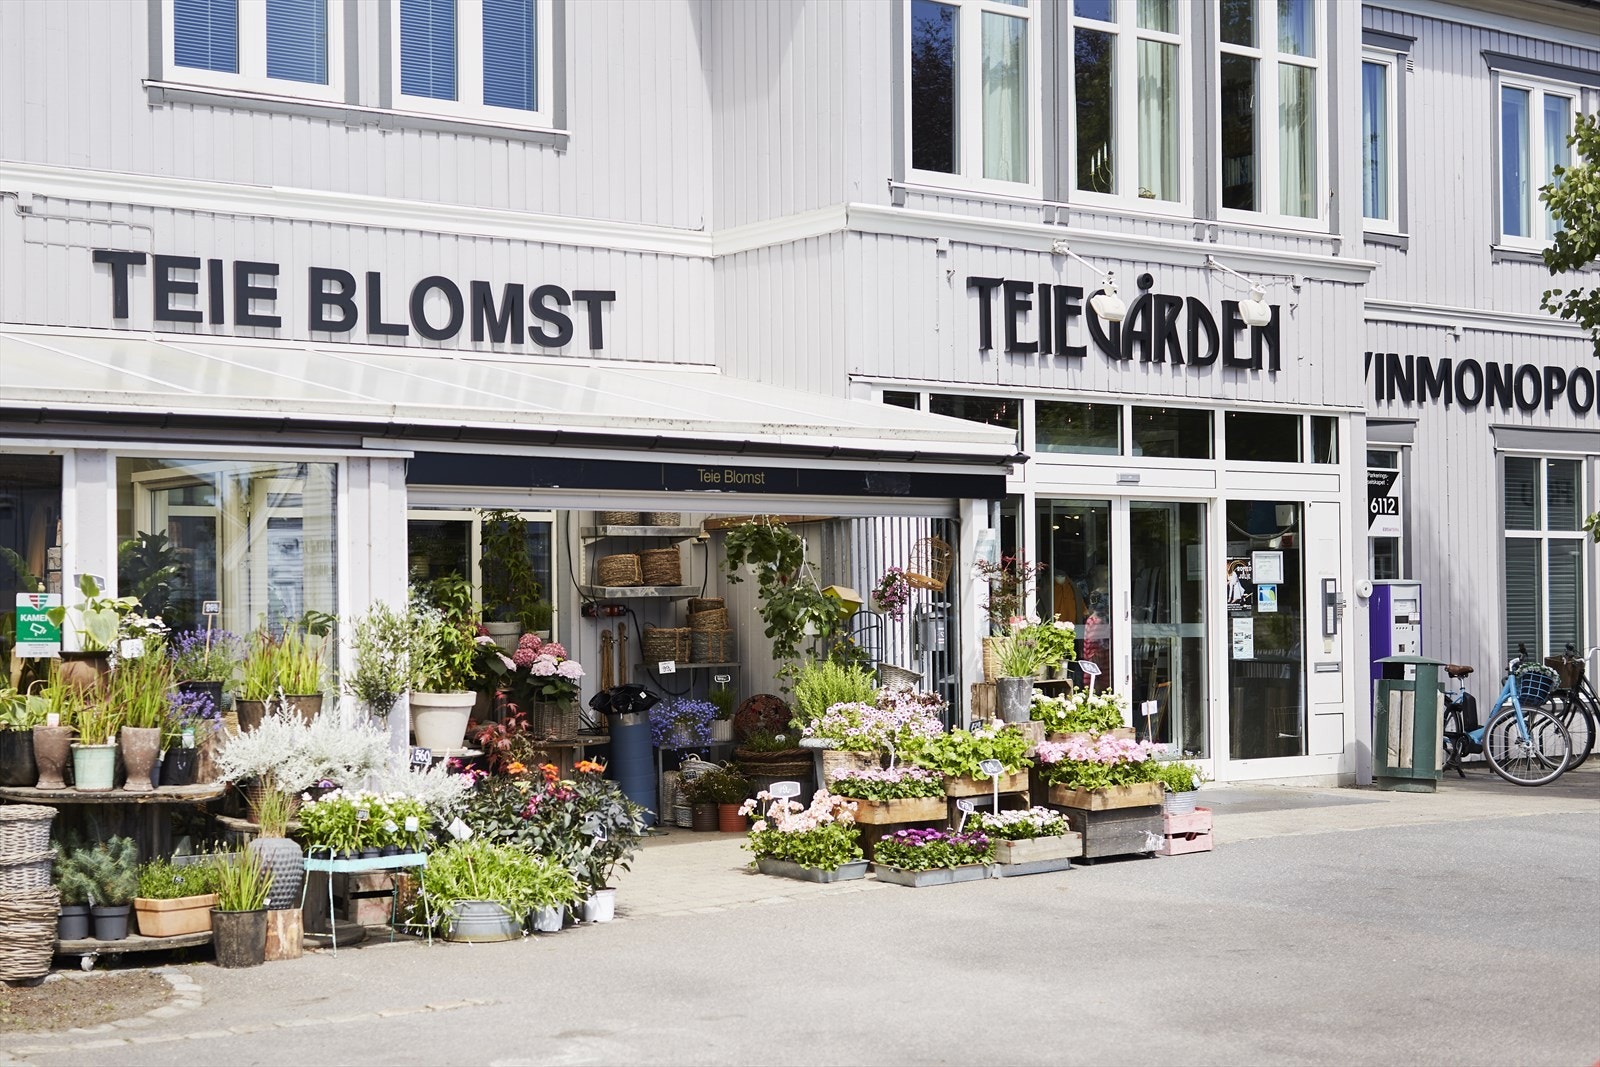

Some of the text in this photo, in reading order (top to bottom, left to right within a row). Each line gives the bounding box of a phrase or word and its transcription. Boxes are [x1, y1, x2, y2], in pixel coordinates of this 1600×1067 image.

[92, 249, 616, 350] TEIE BLOMST
[966, 272, 1281, 372] TEIEGÅRDEN
[1364, 351, 1600, 414] INMONOPO
[697, 468, 765, 484] Teie Blomst
[1370, 497, 1396, 514] 6112
[20, 614, 49, 622] KAME
[415, 749, 430, 762] 560
